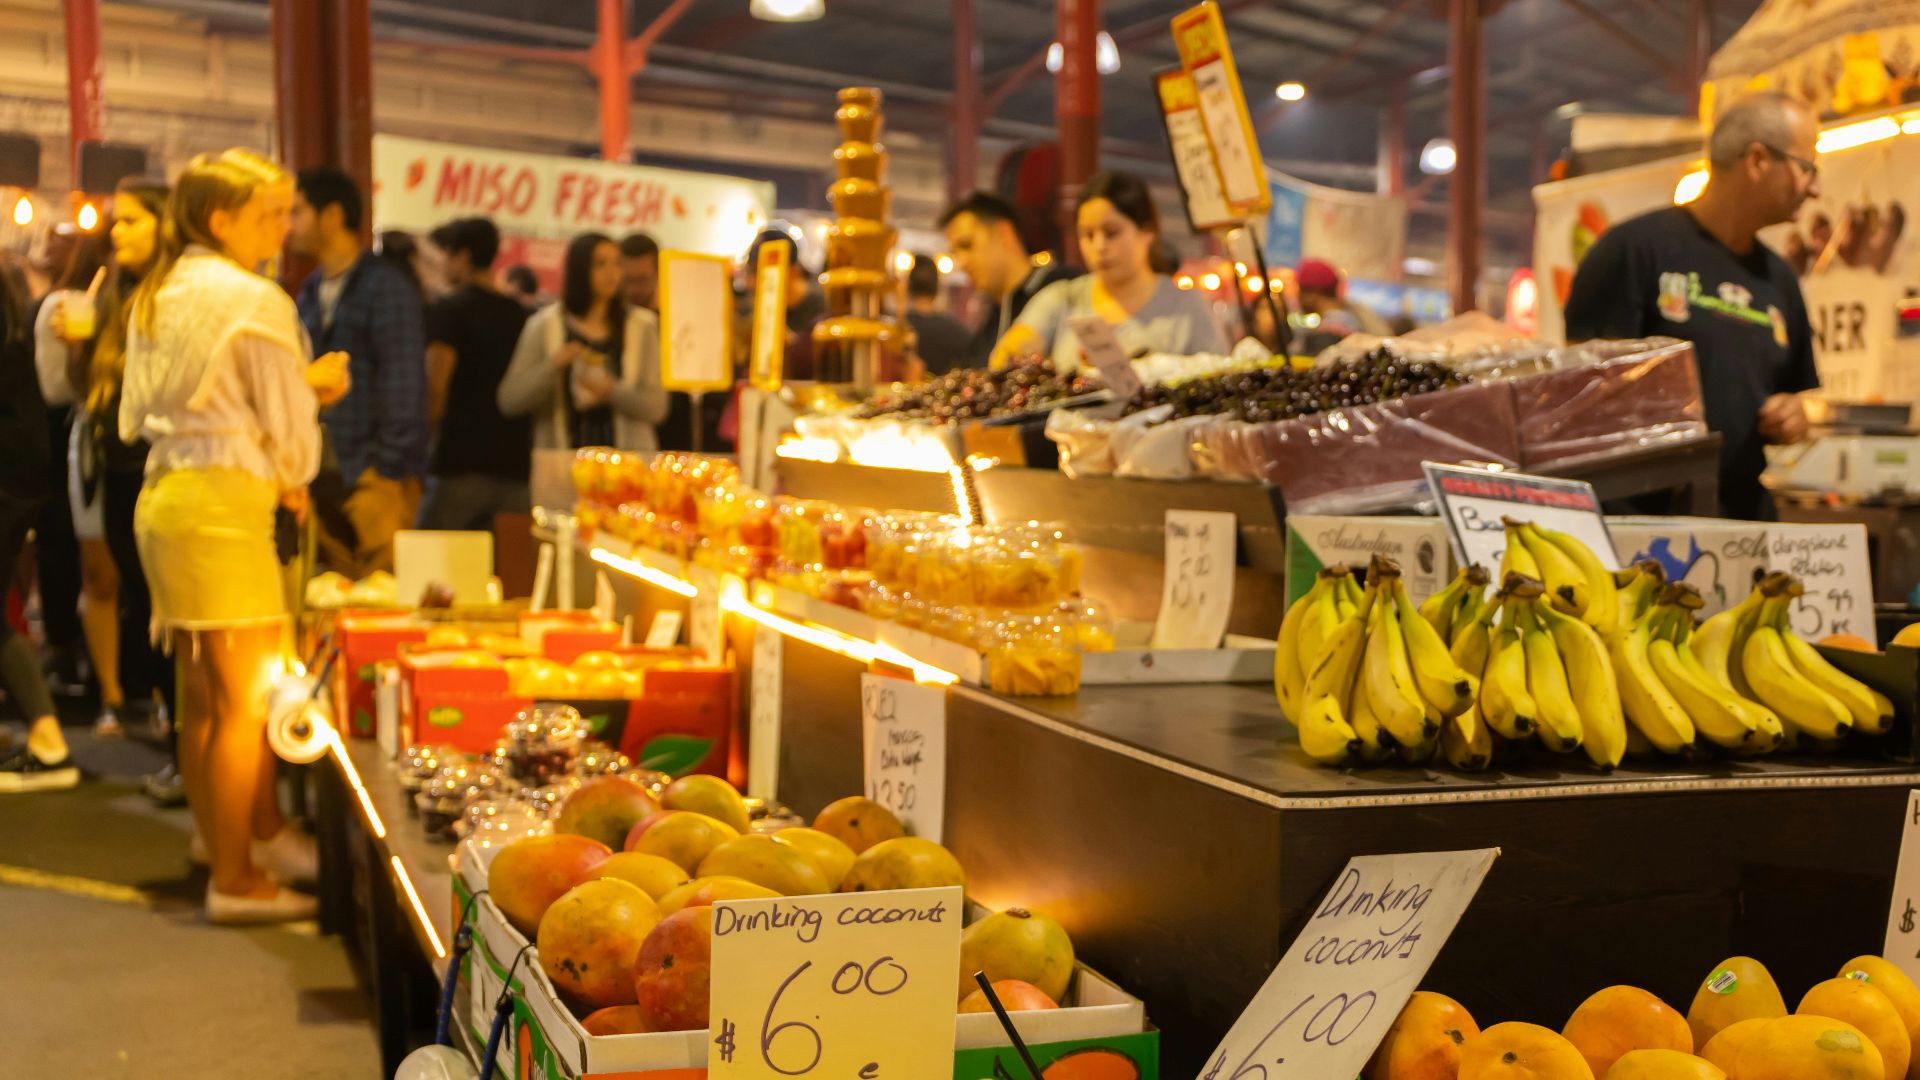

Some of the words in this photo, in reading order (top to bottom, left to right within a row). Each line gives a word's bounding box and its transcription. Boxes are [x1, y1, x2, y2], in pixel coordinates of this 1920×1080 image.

[434, 156, 539, 216] MISO
[552, 171, 666, 226] FRESH
[714, 903, 822, 943] Drinking
[837, 901, 946, 925] coconuts
[1316, 868, 1433, 936] Drinking
[1304, 921, 1423, 965] coconuts
